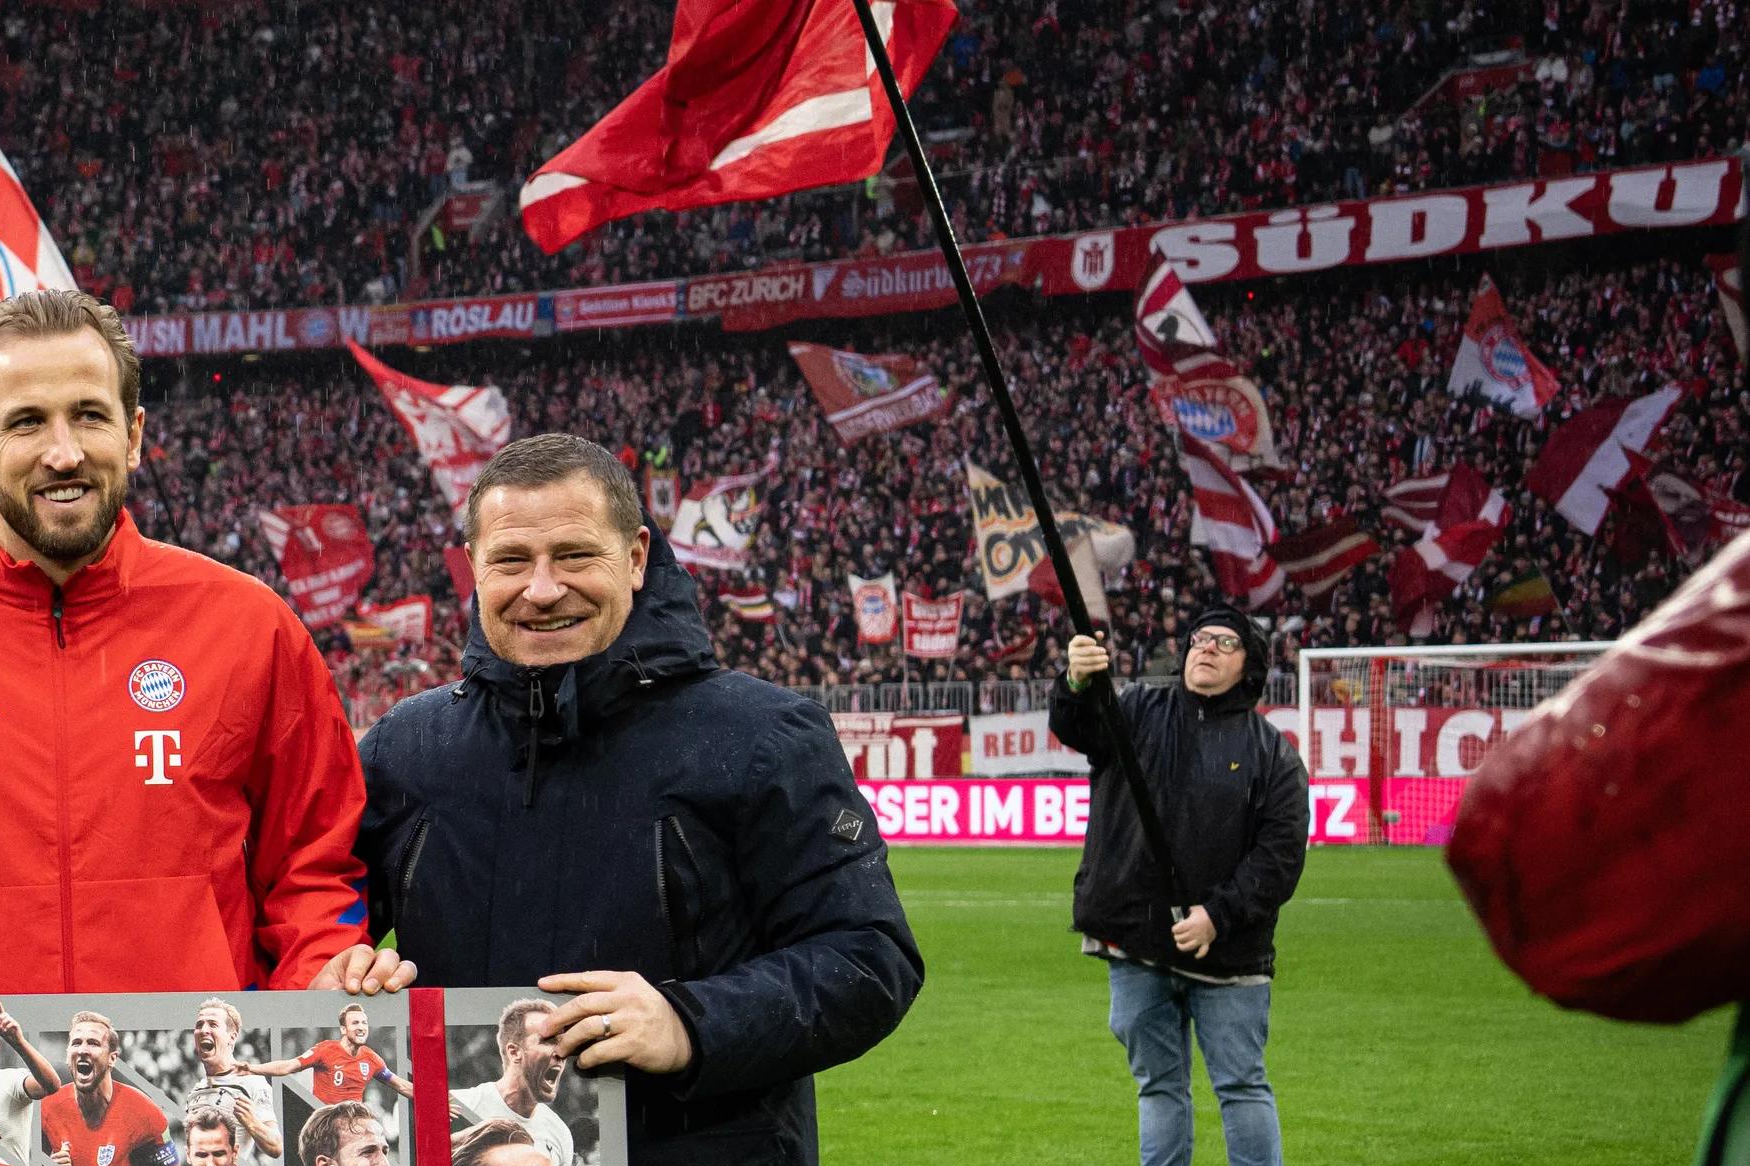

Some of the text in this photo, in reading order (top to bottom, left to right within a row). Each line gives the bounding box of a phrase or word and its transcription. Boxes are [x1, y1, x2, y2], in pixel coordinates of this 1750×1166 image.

[1151, 159, 1744, 283] SÜDKU
[841, 264, 956, 298] Südkurv
[133, 662, 181, 683] FC BAYERN
[134, 690, 181, 709] MÜNCHEN
[134, 730, 181, 785] T
[983, 727, 1034, 757] RED
[968, 784, 1023, 834] IM
[333, 1071, 344, 1086] 9
